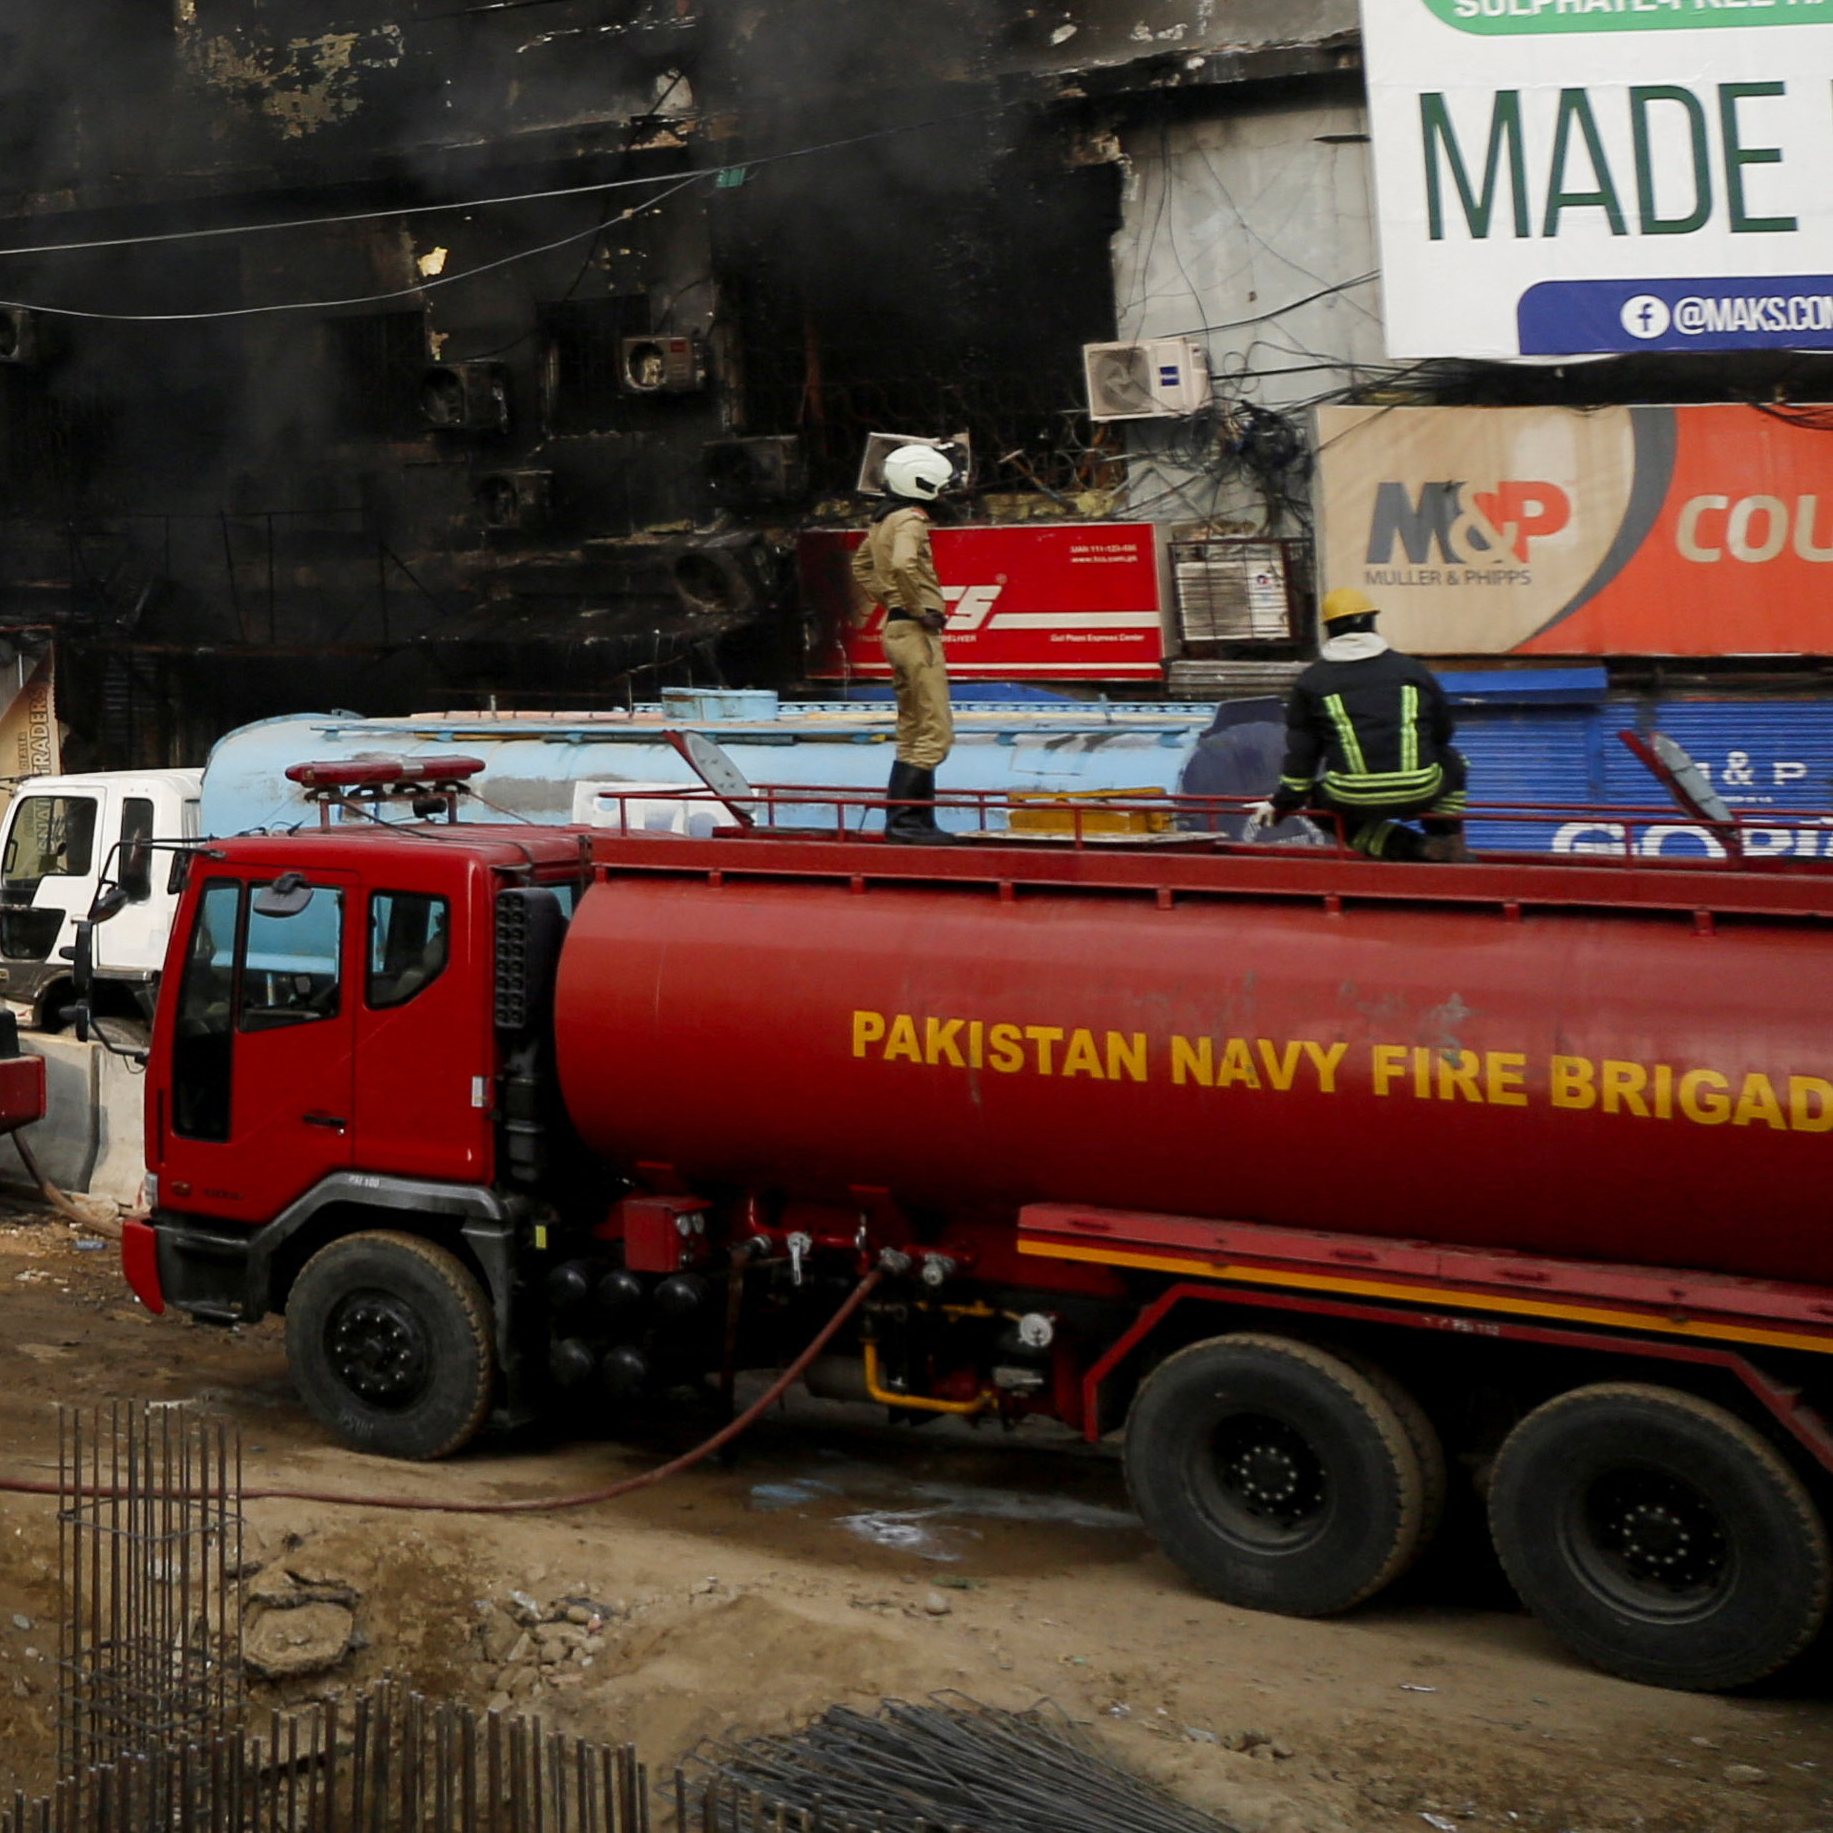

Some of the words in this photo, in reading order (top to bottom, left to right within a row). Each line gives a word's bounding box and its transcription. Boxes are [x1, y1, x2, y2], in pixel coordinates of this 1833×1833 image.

[1420, 80, 1800, 241] MADE
[1364, 479, 1572, 564] M&P
[1363, 569, 1442, 587] MULLER
[1445, 569, 1461, 586] &
[1463, 568, 1533, 586] PHIPPS
[1721, 751, 1754, 786] &
[1773, 761, 1808, 785] P
[850, 1010, 1149, 1083] PAKISTAN
[1169, 1034, 1348, 1094] NAVY
[1372, 1044, 1529, 1108] FIRE
